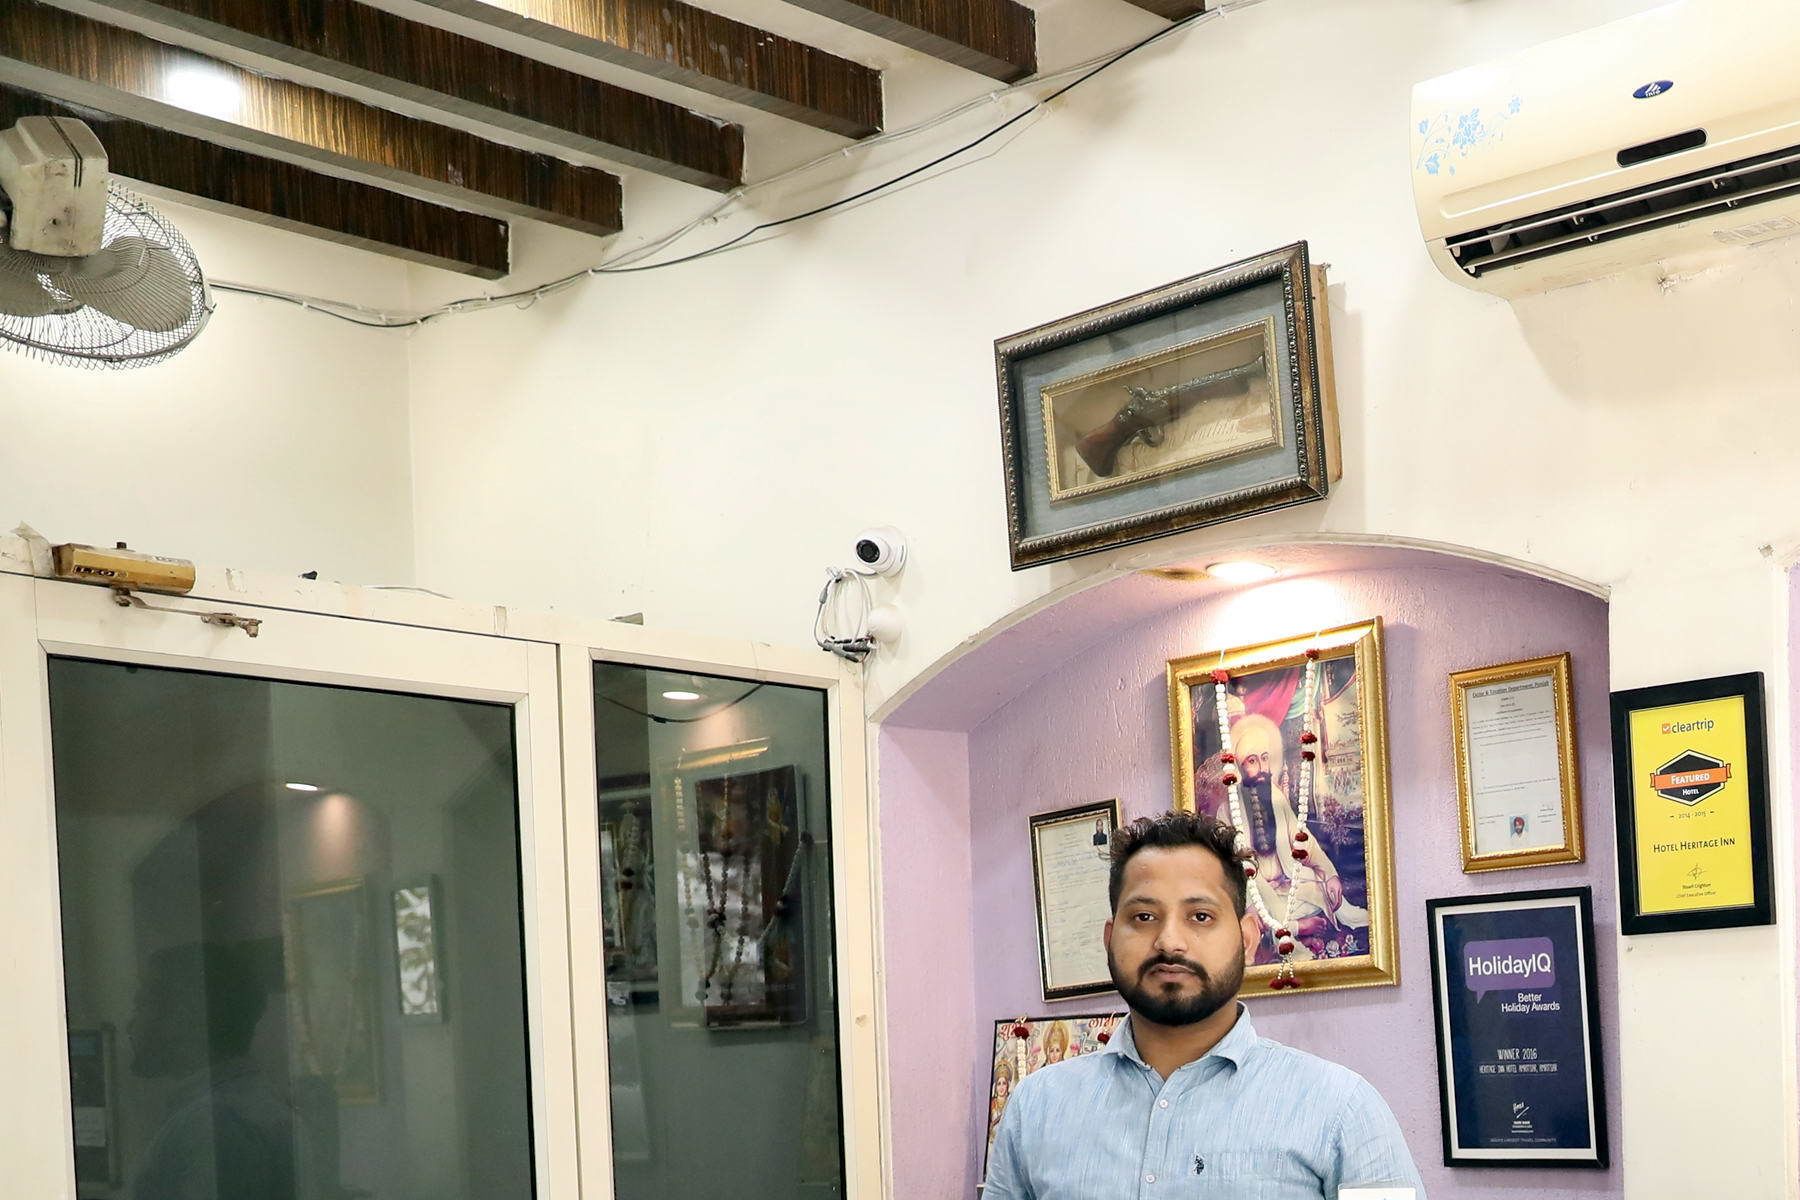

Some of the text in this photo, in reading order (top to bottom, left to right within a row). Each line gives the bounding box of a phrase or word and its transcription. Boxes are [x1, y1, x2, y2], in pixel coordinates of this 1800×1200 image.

[1672, 717, 1715, 734] cleartrip
[1671, 773, 1710, 785] FEATURED
[1653, 837, 1735, 853] HOTEL HERITAGE INN
[1468, 952, 1551, 978] HolidayIQ
[1517, 992, 1542, 1003] Better
[1501, 1001, 1560, 1014] Holiday Awards
[1497, 1047, 1538, 1060] WINNER 2016
